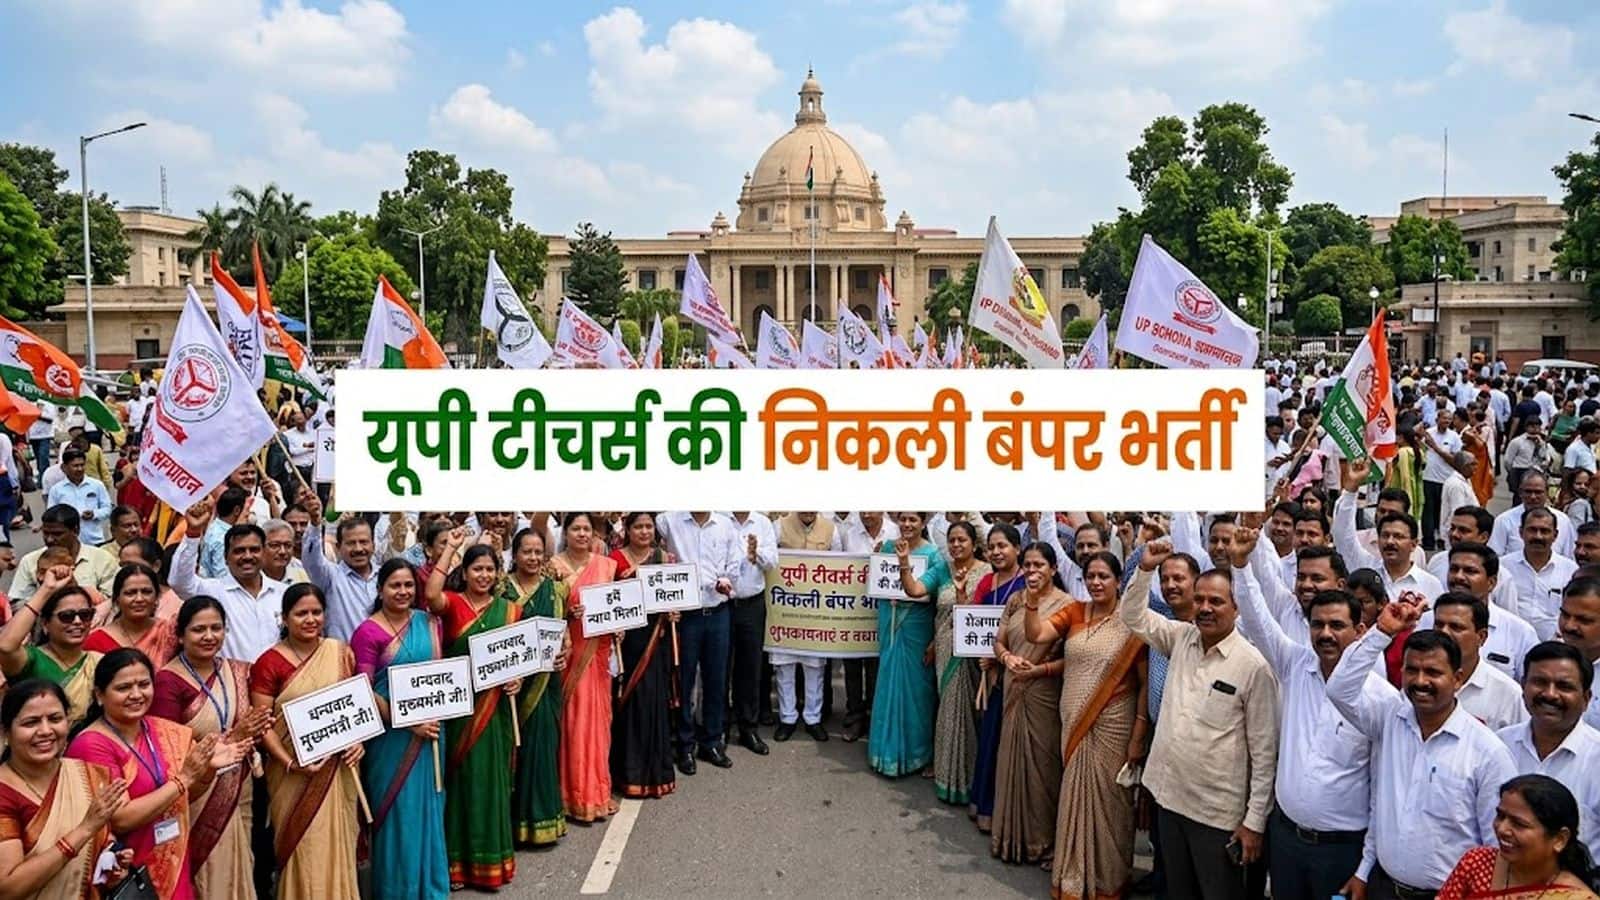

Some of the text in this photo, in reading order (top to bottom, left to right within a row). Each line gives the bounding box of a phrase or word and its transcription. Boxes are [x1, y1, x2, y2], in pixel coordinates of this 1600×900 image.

[1135, 316, 1151, 332] UP
[780, 563, 808, 587] यूपी
[771, 586, 821, 609] निकली
[825, 591, 856, 610] बंपर
[964, 631, 978, 646] की
[410, 672, 454, 689] धन्यवाद
[449, 688, 467, 704] जी!
[308, 693, 355, 721] धन्यवाद
[300, 706, 375, 752] मुख्यमंत्री जी!
